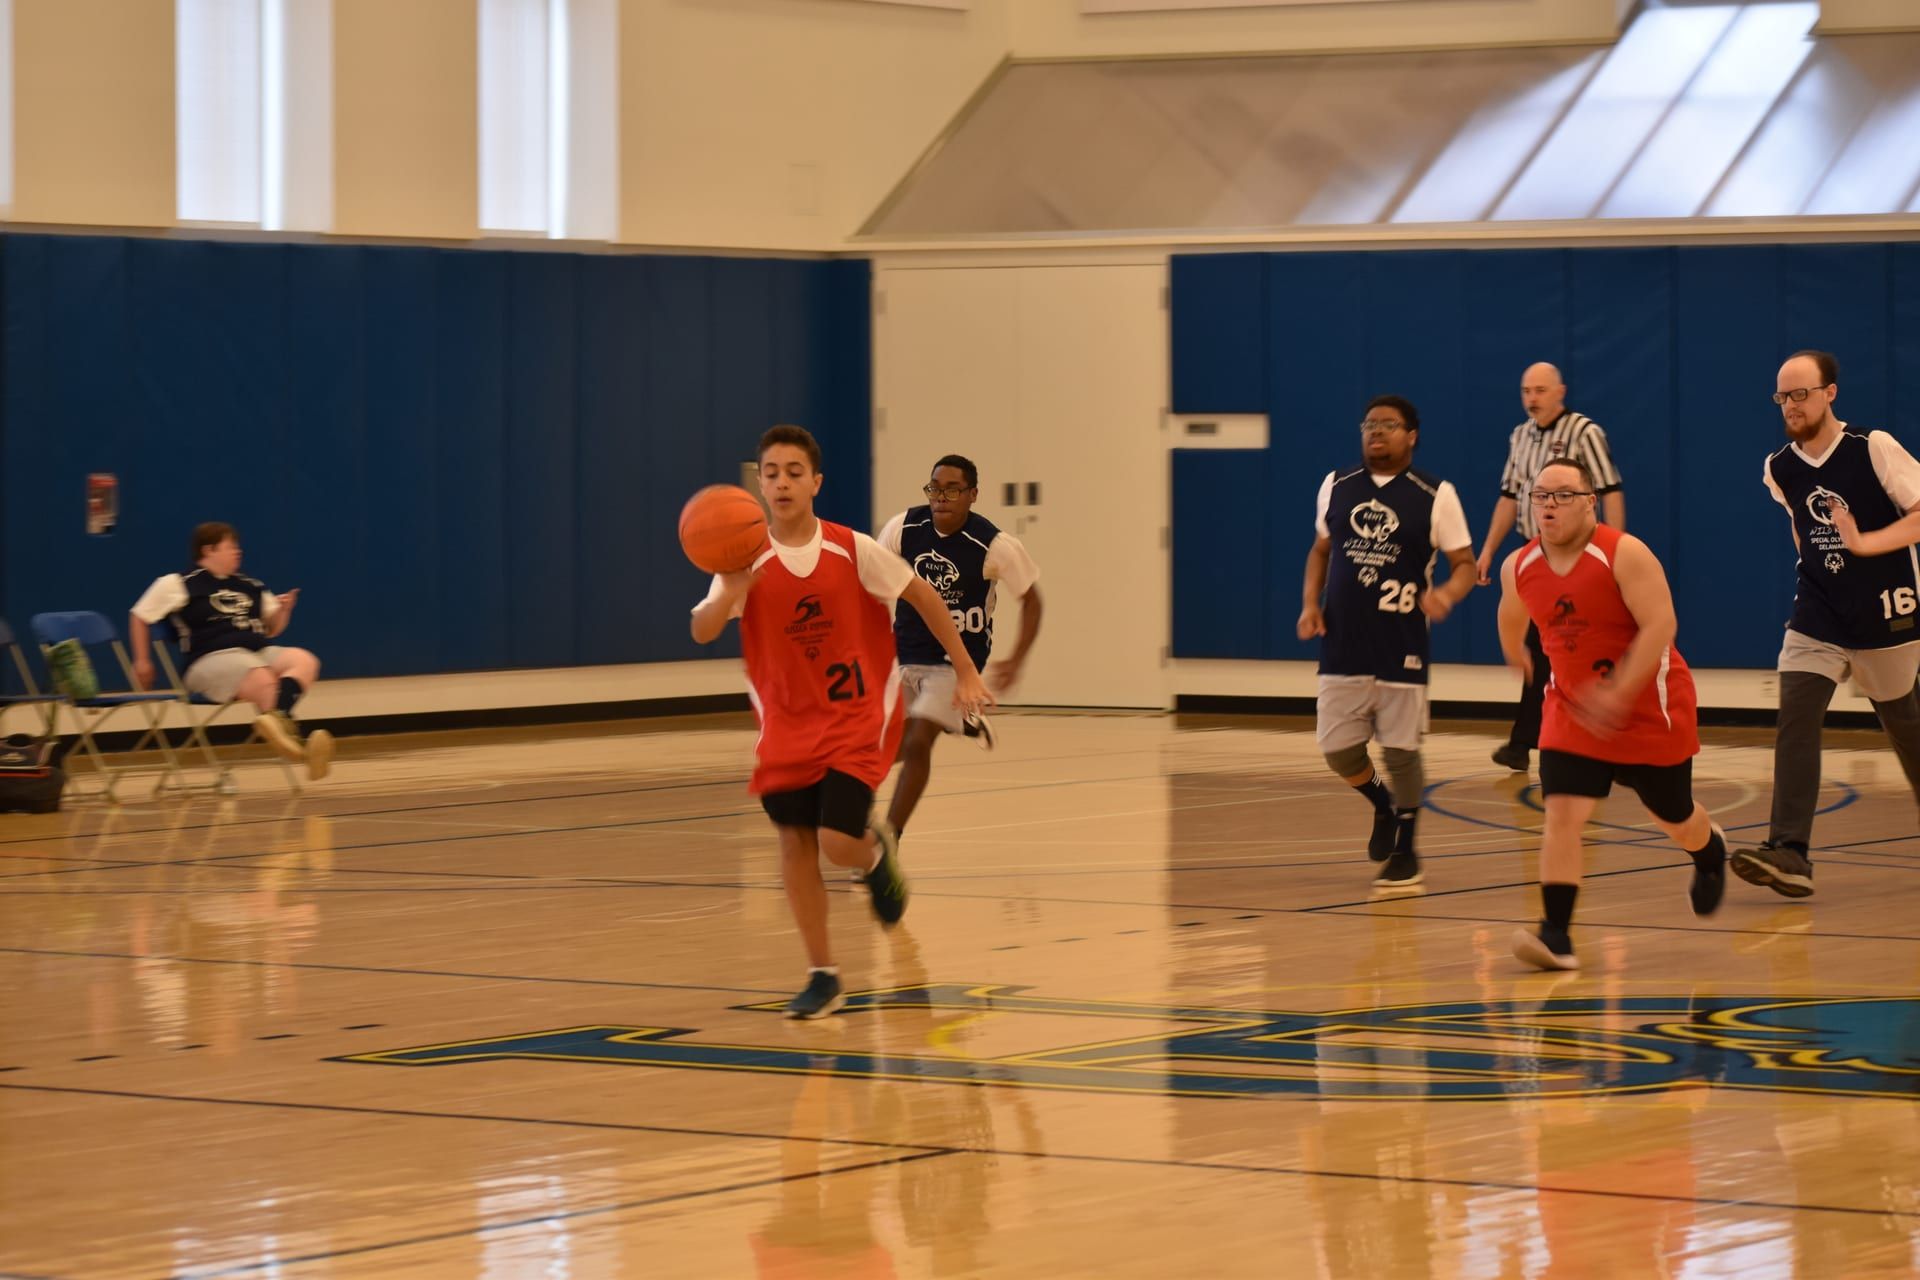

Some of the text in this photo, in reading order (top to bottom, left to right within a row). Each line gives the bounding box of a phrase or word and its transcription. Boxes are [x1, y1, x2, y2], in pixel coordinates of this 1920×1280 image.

[925, 562, 944, 572] KENT
[1378, 578, 1418, 614] 26
[1879, 586, 1917, 619] 16
[825, 656, 865, 702] 21
